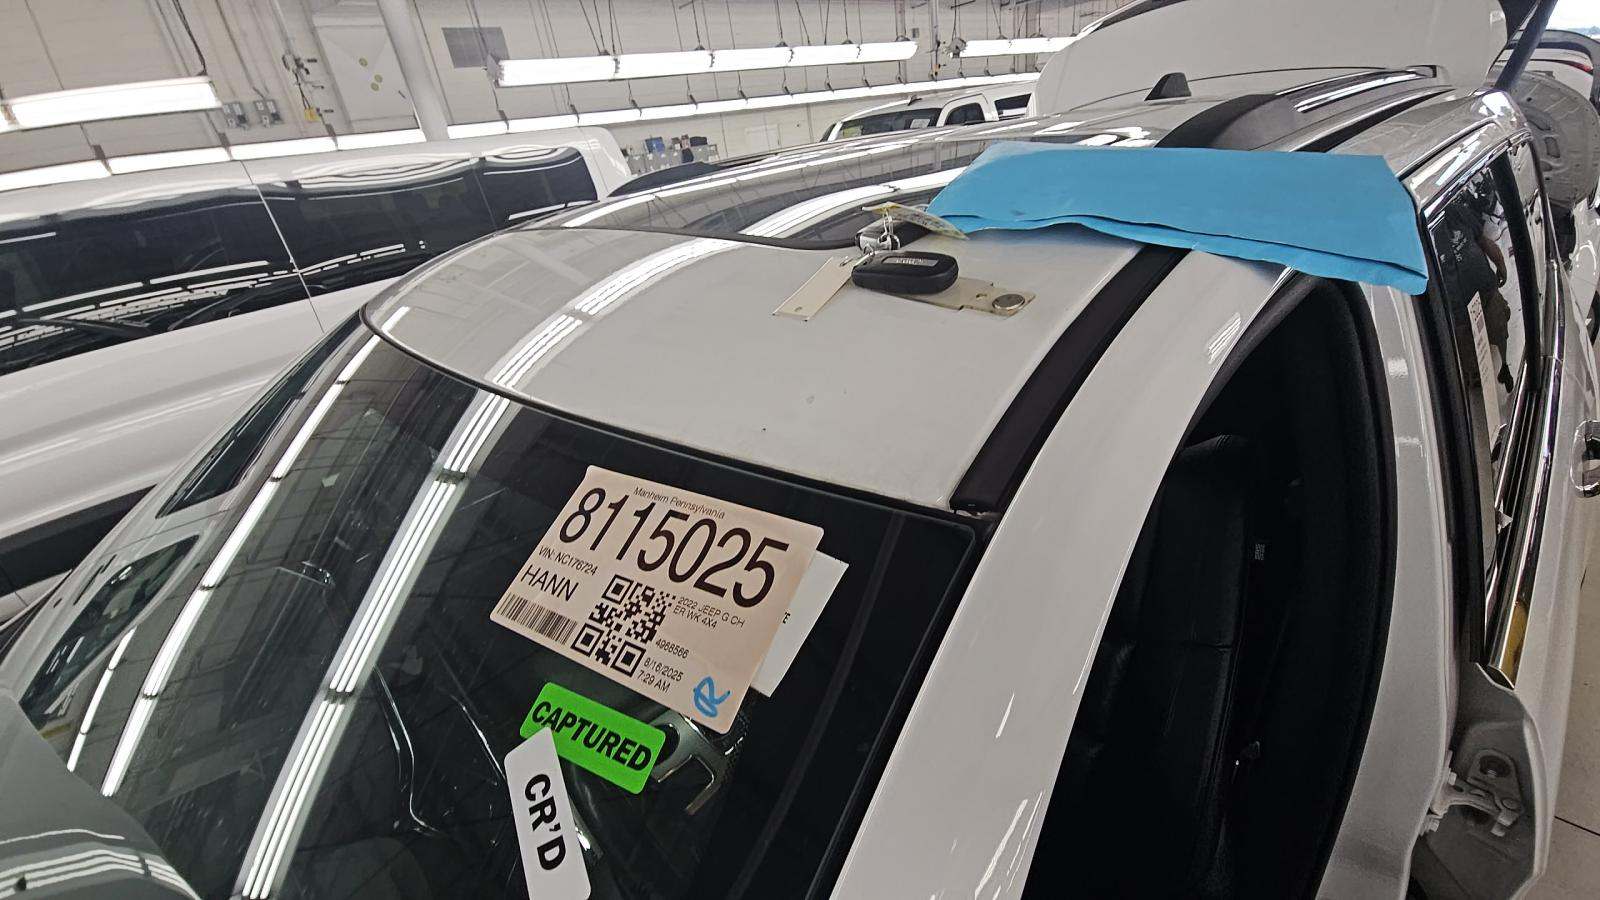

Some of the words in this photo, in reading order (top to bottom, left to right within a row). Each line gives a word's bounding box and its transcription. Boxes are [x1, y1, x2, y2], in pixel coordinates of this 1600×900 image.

[633, 486, 669, 502] Manheim
[669, 496, 725, 519] Pennsylvania
[538, 545, 556, 560] VIN:
[555, 552, 599, 577] NC176724
[559, 487, 790, 608] 8115025
[520, 564, 580, 601] HANN
[673, 605, 687, 617] ER
[686, 610, 702, 623] WK
[701, 616, 718, 629] 4X4
[677, 597, 699, 611] 2022
[698, 604, 721, 617] JEEP
[721, 612, 730, 622] G
[730, 616, 746, 628] CH
[637, 669, 655, 686] 7:29
[654, 679, 671, 693] AM
[643, 657, 684, 682] 8/16/2025
[532, 701, 652, 772] CAPTURED
[524, 774, 567, 871] CR'D
